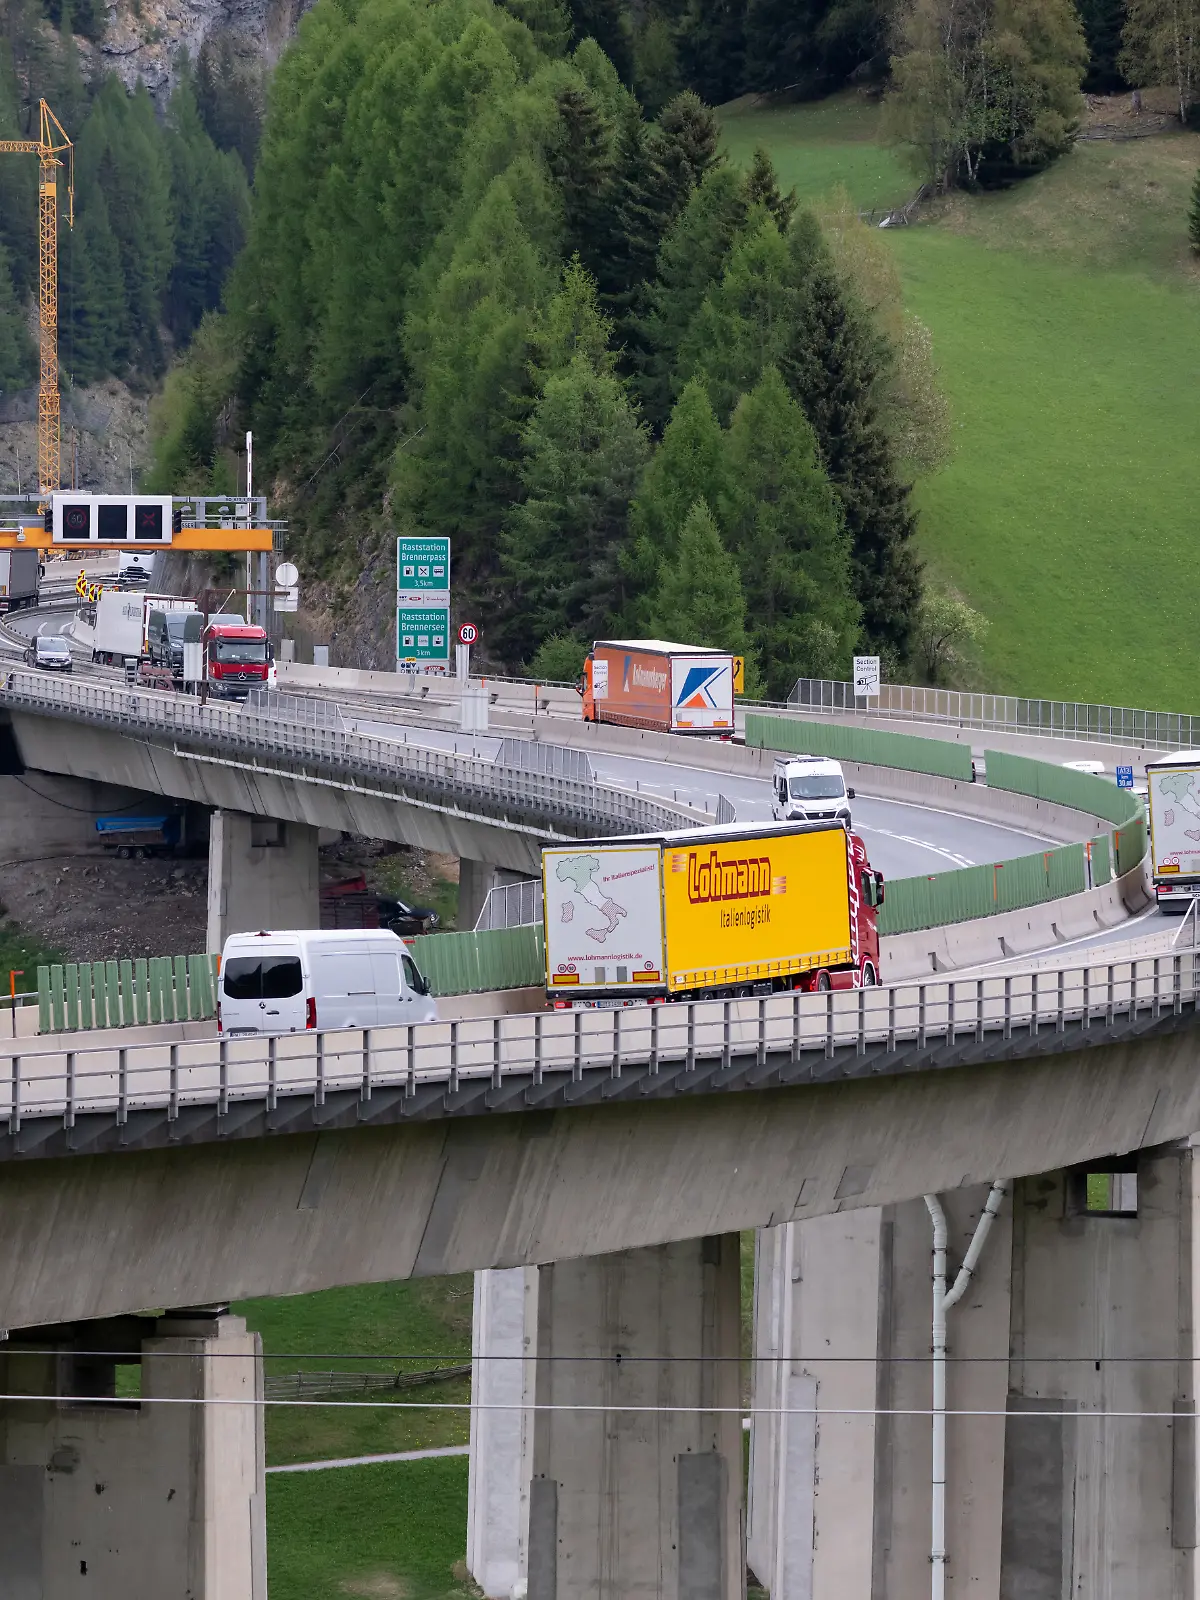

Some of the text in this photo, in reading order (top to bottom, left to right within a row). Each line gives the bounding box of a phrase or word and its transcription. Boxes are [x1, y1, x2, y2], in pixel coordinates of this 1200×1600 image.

[402, 543, 446, 551] Raststation
[401, 553, 446, 562] Brennerpass
[414, 579, 424, 587] 3,5
[401, 613, 445, 621] Raststation
[401, 623, 445, 631] Brennersee
[462, 627, 474, 639] 60
[688, 850, 771, 904] Lohmann
[720, 904, 771, 930] Italienlogistik
[567, 953, 643, 961] www.lohmannlogistik.de
